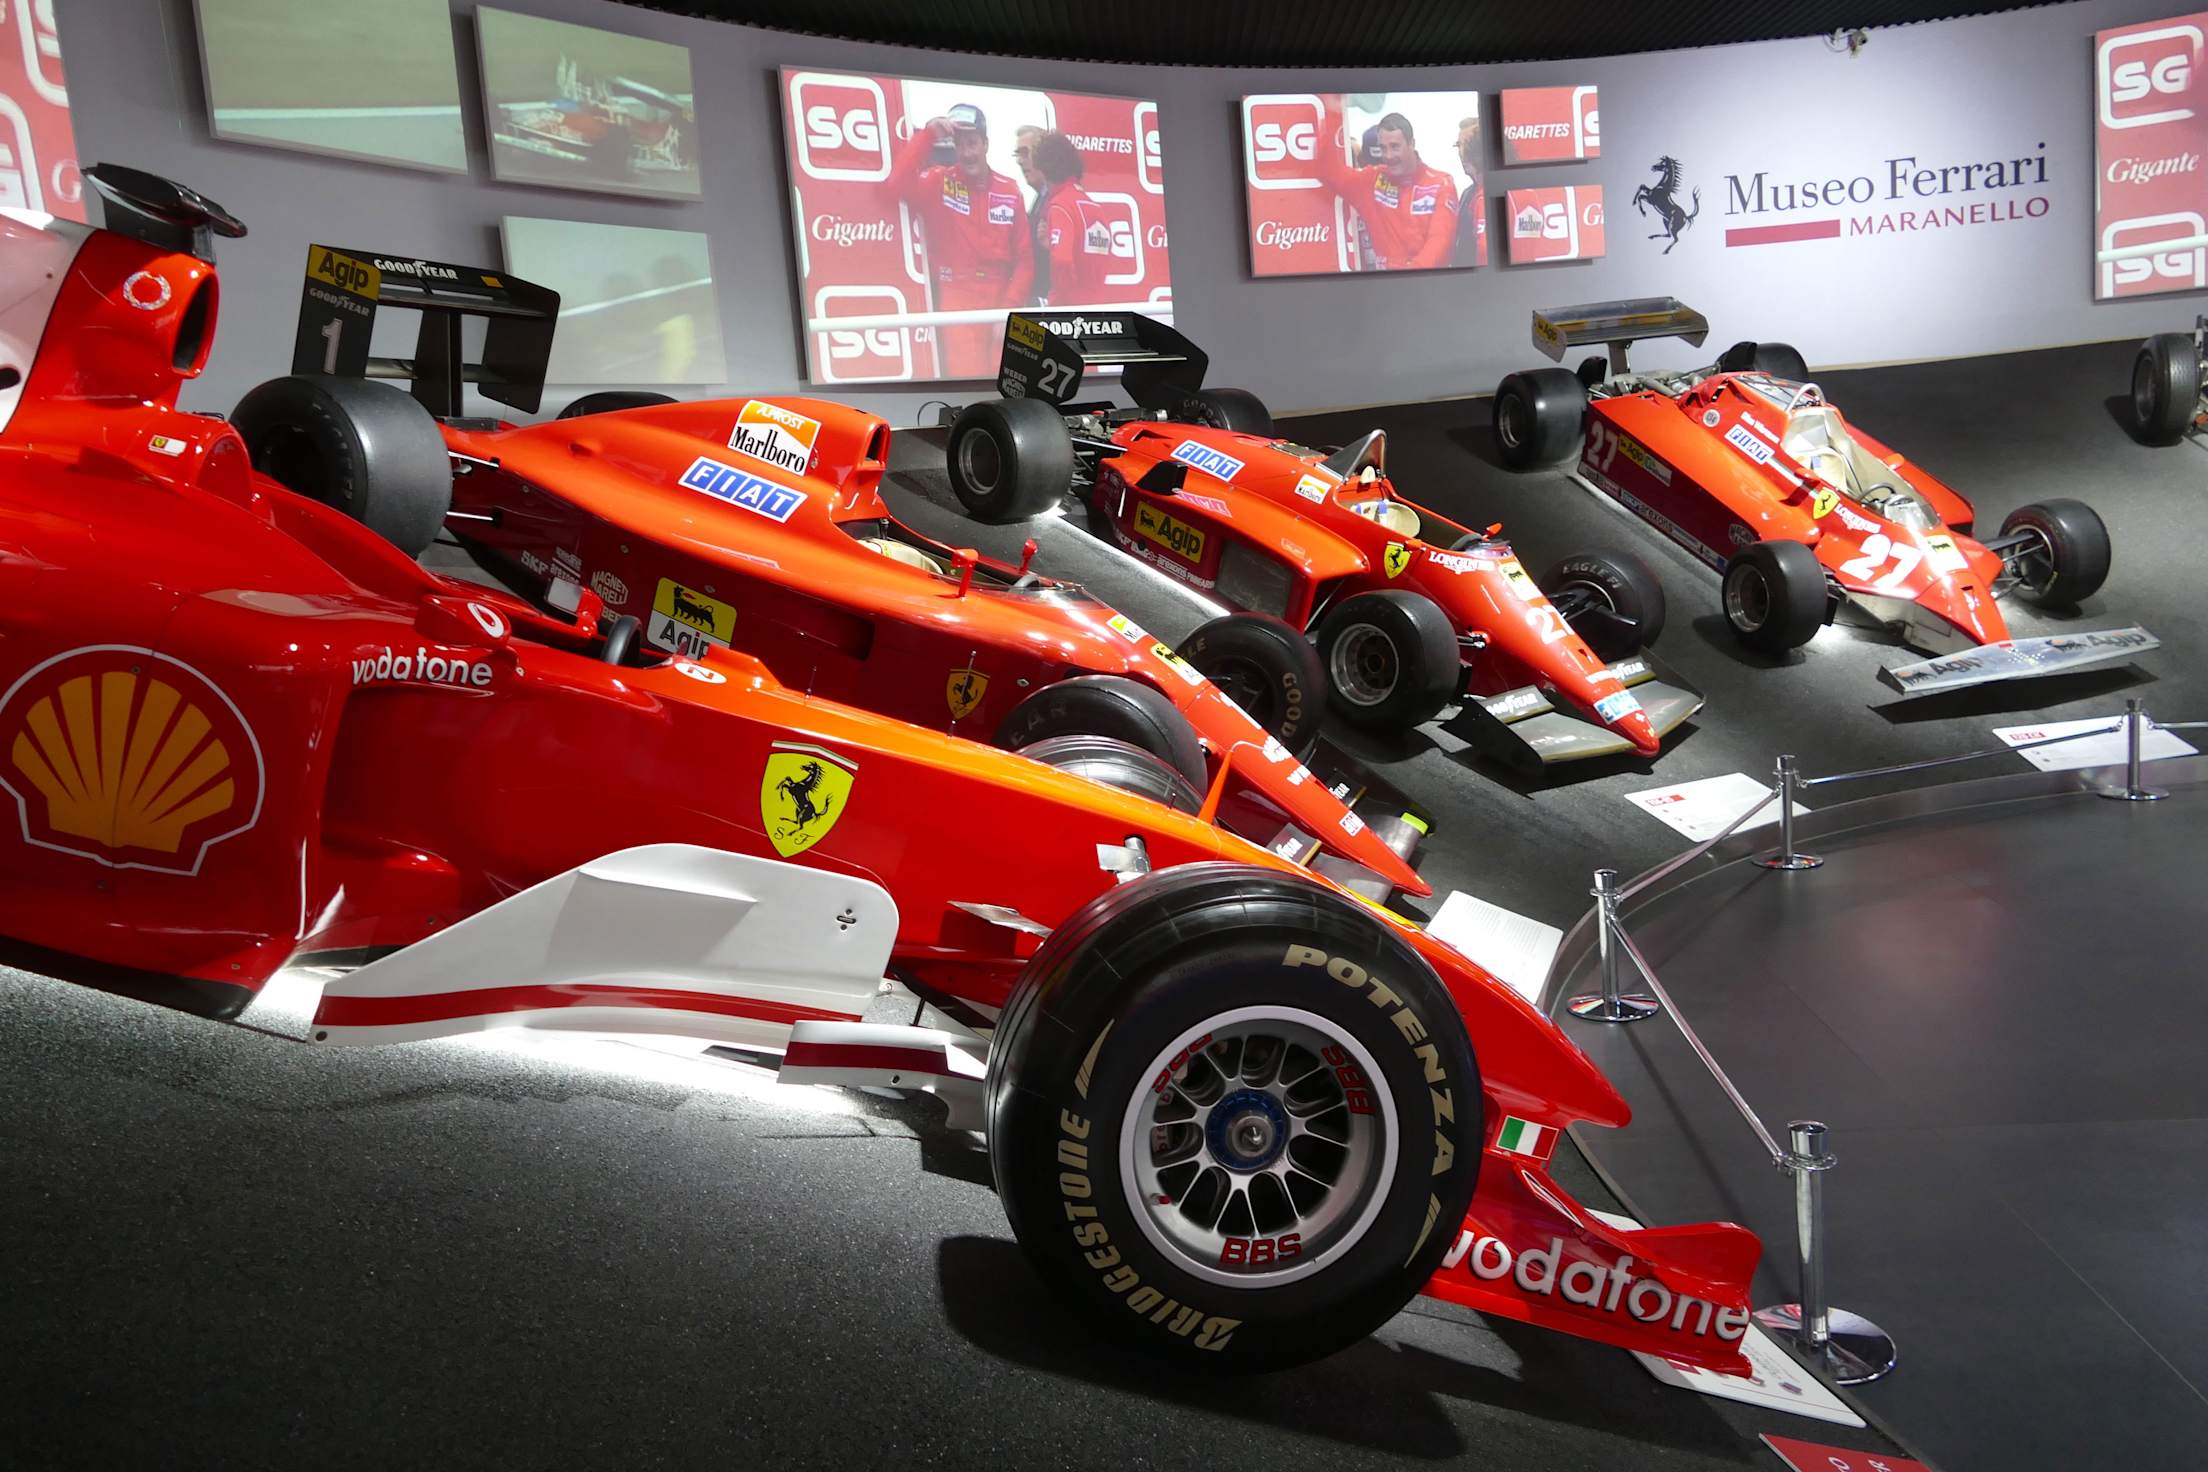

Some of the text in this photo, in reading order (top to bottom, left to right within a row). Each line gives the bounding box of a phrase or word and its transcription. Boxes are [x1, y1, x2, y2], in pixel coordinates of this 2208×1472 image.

[2112, 54, 2191, 103] SG
[807, 106, 880, 152] SG
[1254, 122, 1318, 162] SG
[1724, 142, 2049, 216] Museo Ferrari
[2106, 151, 2200, 184] Gigante
[811, 214, 895, 247] Gigante
[1255, 221, 1331, 250] Gigante
[1849, 196, 2049, 237] MARANELLO
[318, 252, 369, 288] Agip
[320, 317, 344, 375] 1
[1036, 358, 1077, 399] 27
[729, 426, 807, 474] Marlboro
[1178, 442, 1240, 479] FIAT
[1586, 420, 1618, 473] 27
[1728, 426, 1773, 463] FIAT
[690, 462, 796, 514] FIAT
[1157, 515, 1201, 556] Agip
[520, 549, 549, 576] SKF
[1838, 533, 1926, 592] 27
[2086, 630, 2148, 649] Agip
[351, 646, 493, 686] vodafone
[1928, 655, 1987, 677] Agip
[1281, 943, 1456, 1177] POTENZA
[1320, 1043, 1377, 1116] BBS
[1056, 1106, 1243, 1353] BRIDGESTONE
[1218, 1232, 1303, 1266] BBS
